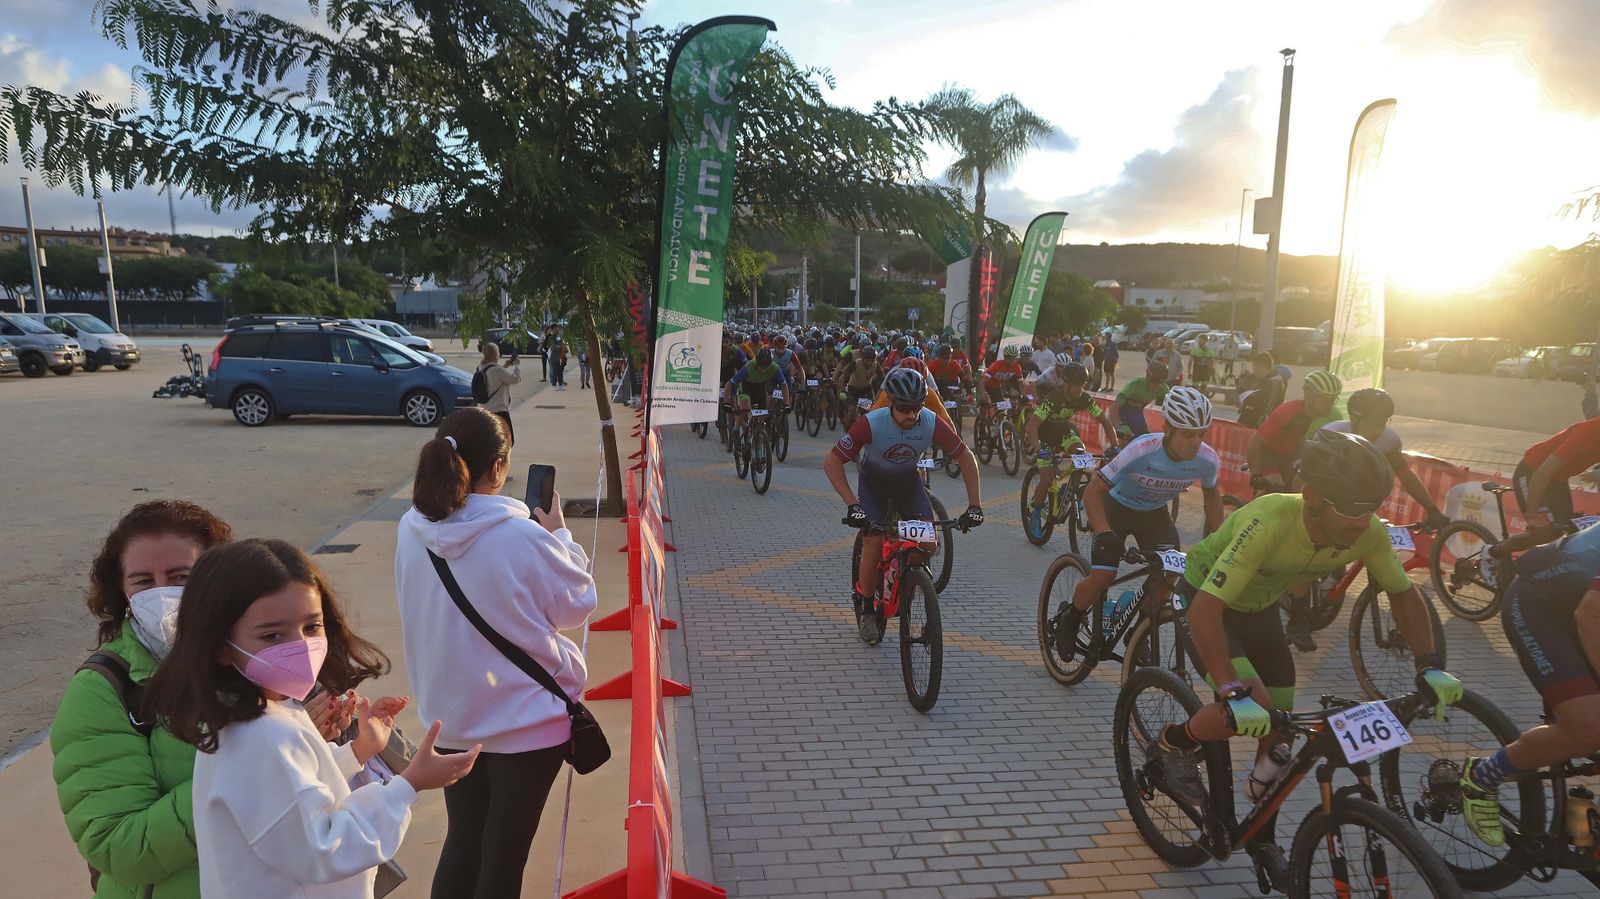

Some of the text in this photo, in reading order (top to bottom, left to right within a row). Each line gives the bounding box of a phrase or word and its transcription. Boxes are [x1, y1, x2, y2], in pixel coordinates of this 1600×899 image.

[1021, 229, 1054, 320] ÚNETE
[851, 512, 866, 520] FOX
[969, 513, 984, 521] FOX
[901, 526, 926, 539] 107
[1164, 554, 1186, 569] 438
[1342, 719, 1391, 751] 146
